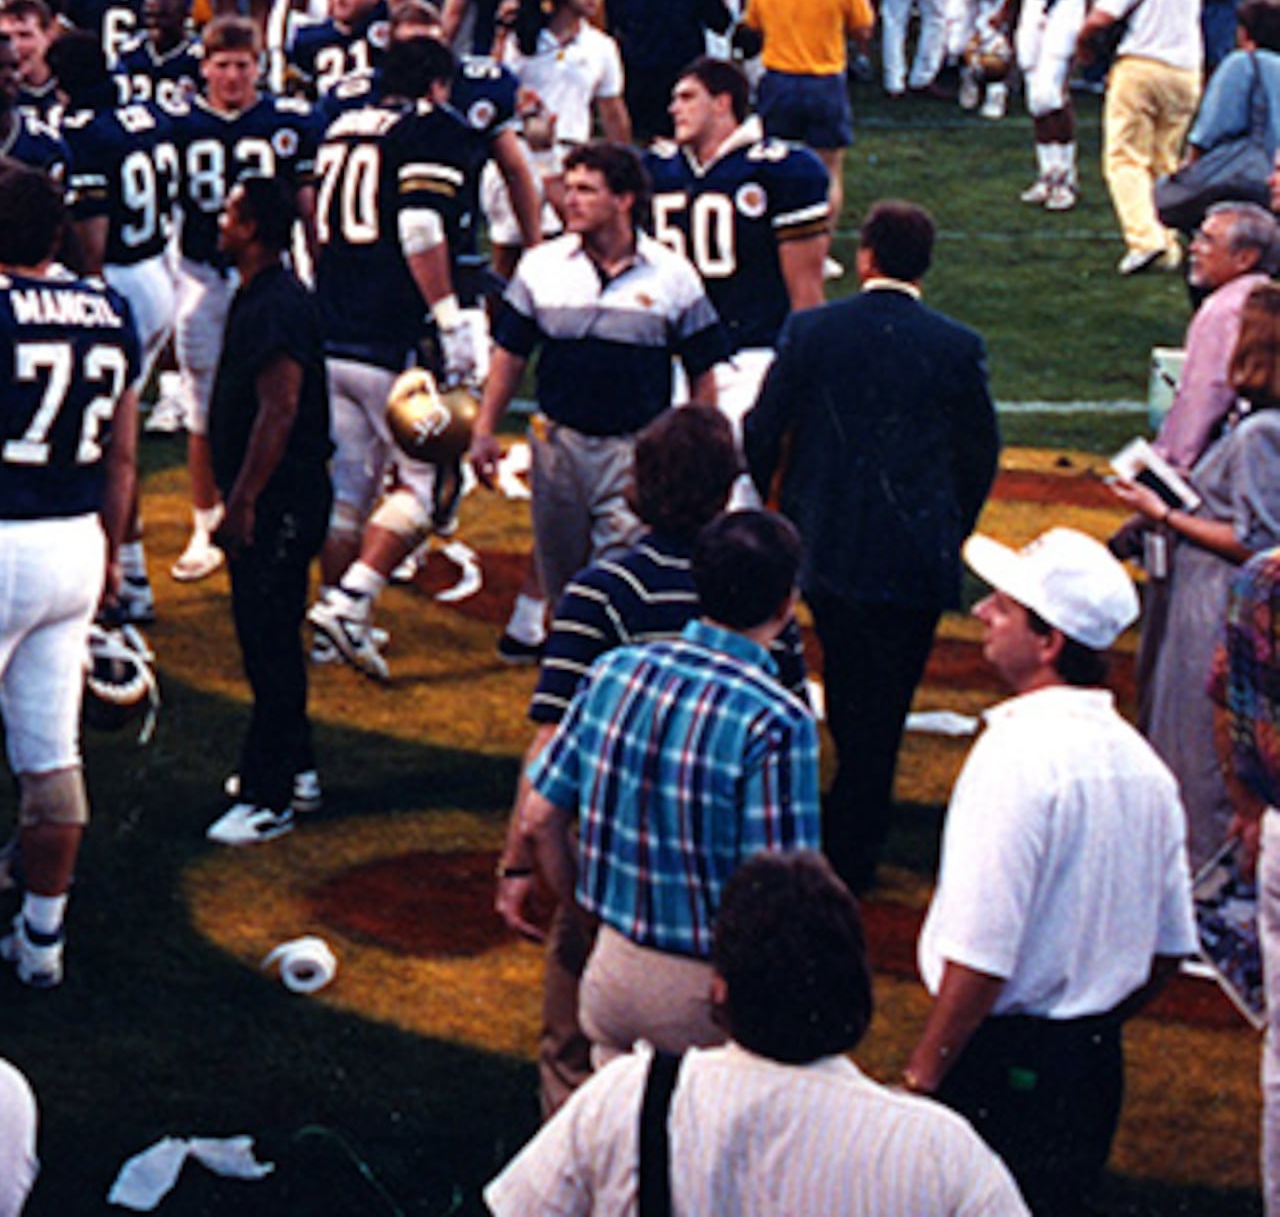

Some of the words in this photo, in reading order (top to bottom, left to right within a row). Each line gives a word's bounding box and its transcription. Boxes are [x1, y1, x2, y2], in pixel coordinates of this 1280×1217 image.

[314, 142, 381, 244] 70
[652, 192, 734, 278] 50
[1, 342, 130, 465] 72
